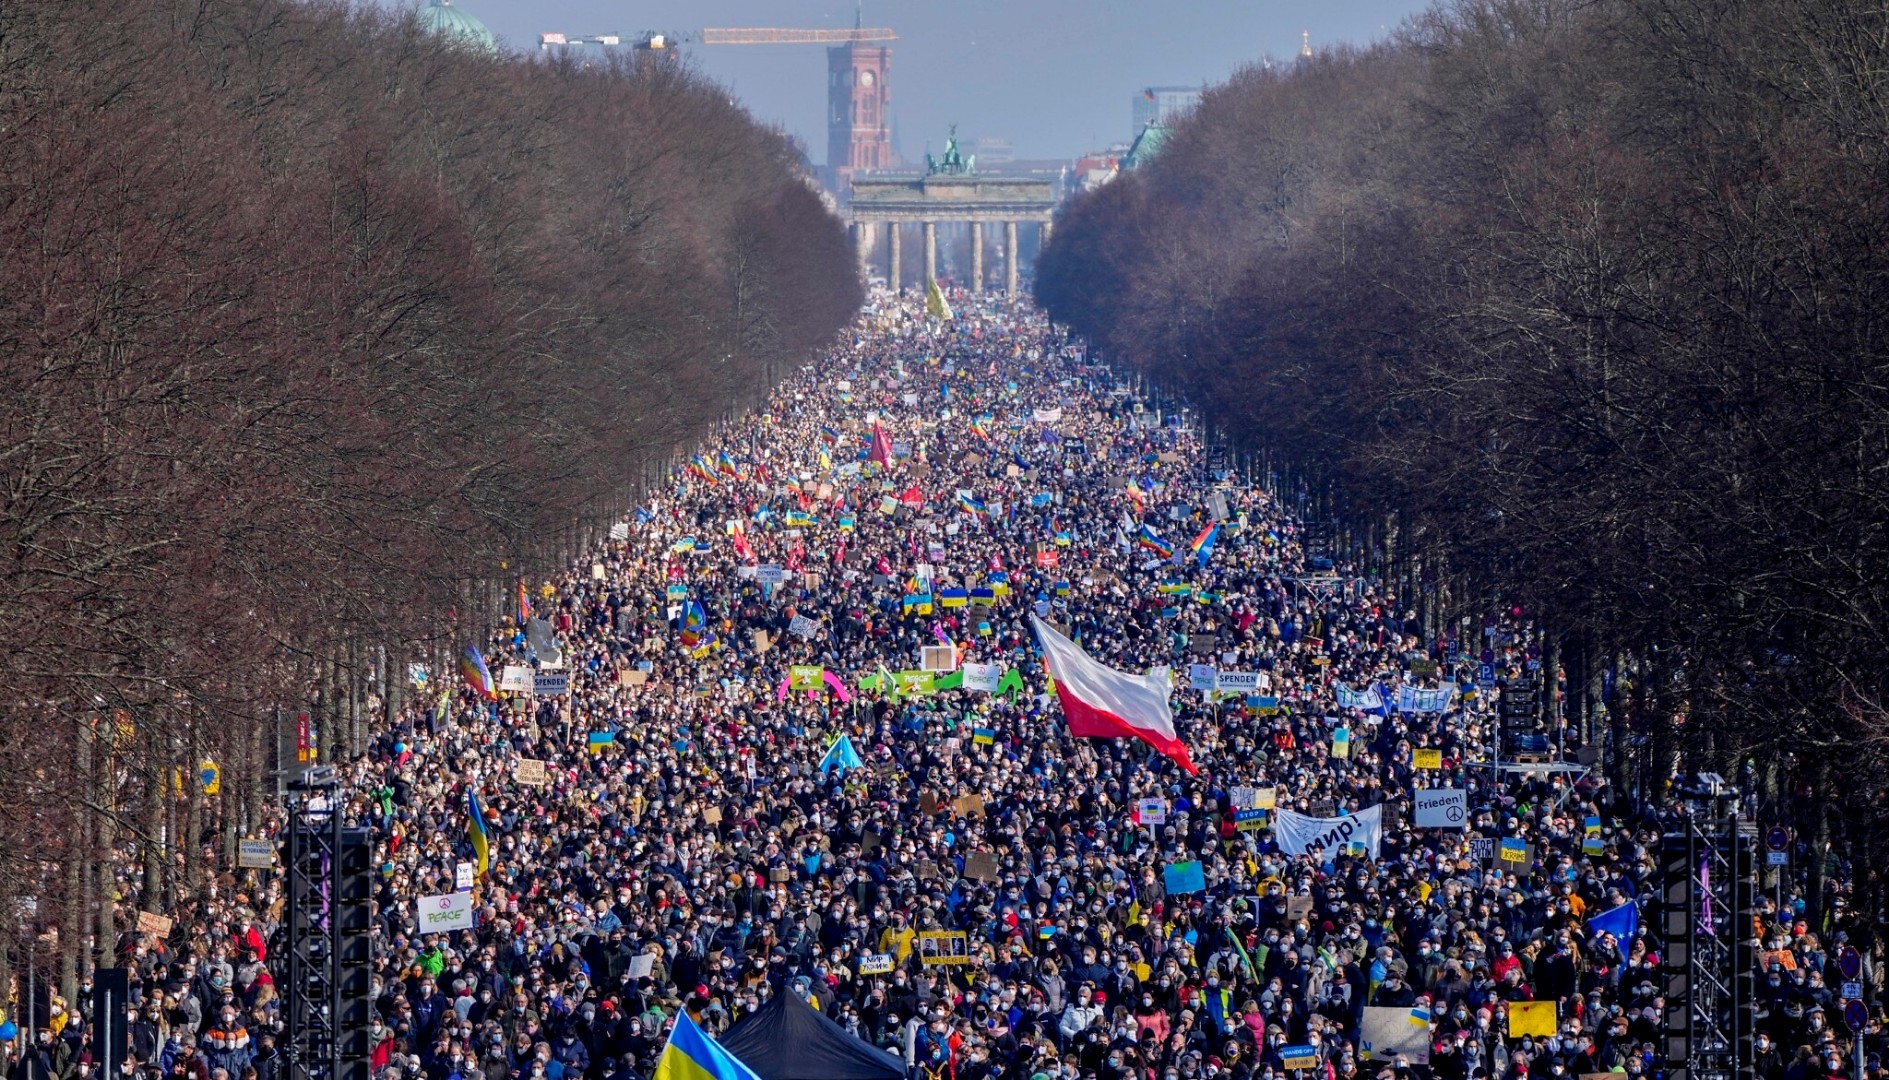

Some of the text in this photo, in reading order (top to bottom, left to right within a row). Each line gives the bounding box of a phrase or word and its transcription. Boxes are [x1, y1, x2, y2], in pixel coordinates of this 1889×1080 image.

[795, 667, 821, 677] PEACE
[1482, 665, 1490, 678] P
[534, 677, 566, 686] SPENDEN
[904, 674, 931, 683] PEACE
[968, 674, 993, 684] PEACE
[1219, 674, 1256, 683] SPENDEN
[1232, 786, 1255, 798] STOP
[1418, 793, 1464, 810] Frieden!
[1470, 840, 1492, 848] STOP
[1471, 848, 1492, 858] PUTIN
[427, 908, 464, 923] PEACE
